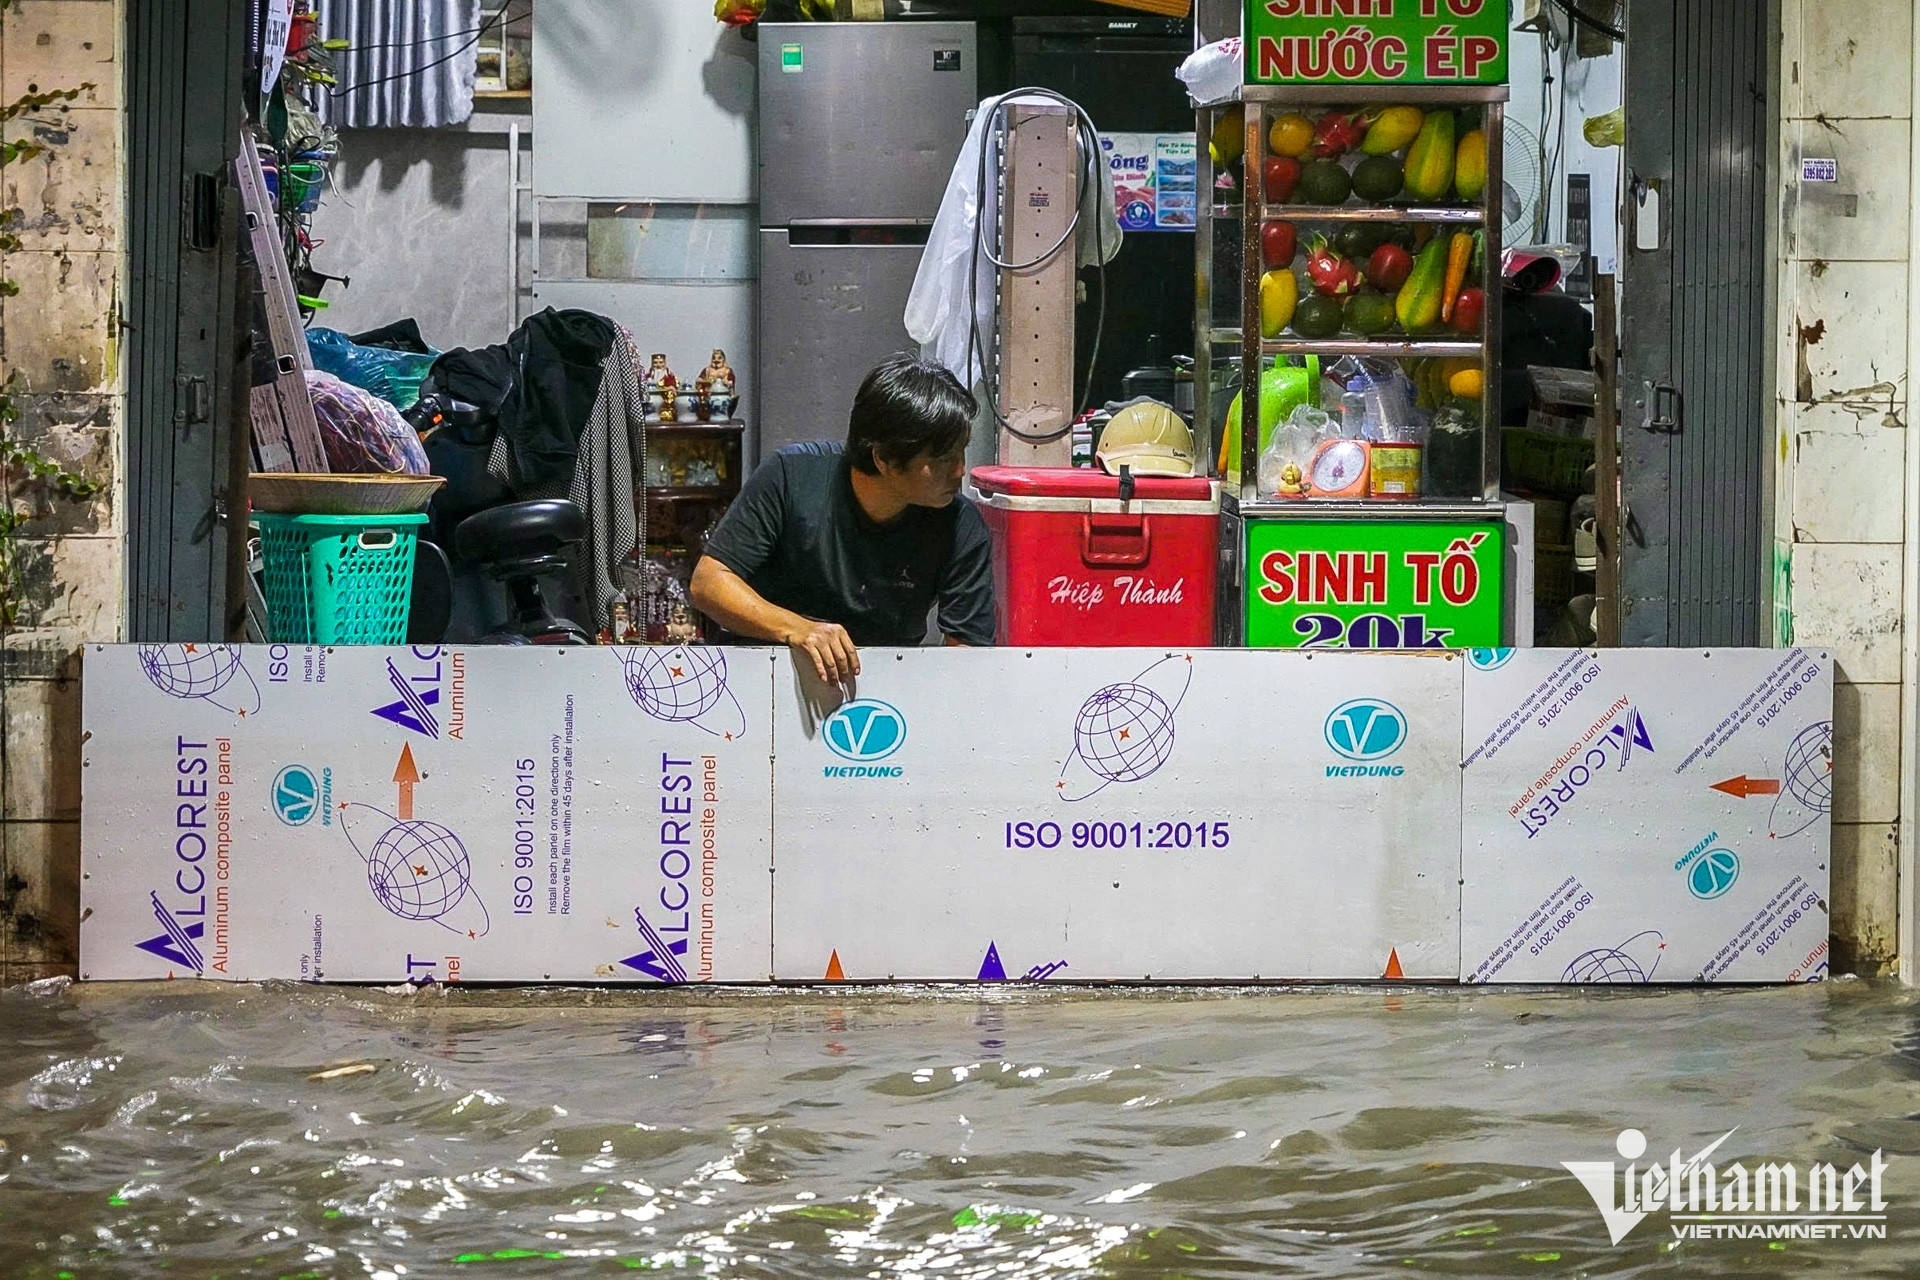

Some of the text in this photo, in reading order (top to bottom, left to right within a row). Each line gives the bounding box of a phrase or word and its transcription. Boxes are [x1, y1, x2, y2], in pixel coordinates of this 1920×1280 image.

[1258, 25, 1499, 79] NƯỚC ÉP
[1259, 532, 1490, 606] SINH TỐ
[1048, 576, 1183, 611] Hiệp Thành
[1293, 613, 1453, 648] 20k
[269, 644, 288, 682] ISO
[303, 655, 312, 682] Install
[1558, 648, 1583, 672] Remove
[1777, 648, 1802, 672] Remove
[1536, 682, 1548, 694] film
[1548, 672, 1558, 682] the
[448, 653, 464, 739] Aluminum
[1485, 655, 1589, 760] Install each panel on one direction only
[1520, 693, 1536, 710] within
[1538, 664, 1601, 728] ISO 9001:2015
[1705, 654, 1810, 759] Install each panel on one direction only
[1739, 692, 1756, 710] within
[1756, 664, 1820, 728] ISO 9001:2015
[1497, 719, 1512, 734] days
[1511, 710, 1520, 721] 45
[1716, 718, 1731, 733] days
[1731, 710, 1739, 720] 45
[551, 734, 562, 754] only
[1484, 732, 1497, 746] after
[1704, 732, 1716, 746] after
[1508, 695, 1629, 818] Aluminum composite panel
[550, 756, 559, 795] direction
[701, 756, 718, 801] panel
[823, 765, 903, 778] VIETDUNG
[1325, 765, 1404, 777] VIETDUNG
[1521, 706, 1654, 839] ALCOREST
[322, 767, 332, 826] VIETDUNG
[561, 694, 574, 914] Remove the film within 45 days after installation
[514, 758, 535, 914] ISO 9001:2015
[552, 819, 558, 831] on
[1006, 822, 1230, 848] ISO 9001:2015
[134, 736, 207, 973] ALCOREST
[213, 737, 232, 973] Aluminum composite panel
[549, 834, 560, 859] panel
[700, 809, 717, 897] composite
[1675, 831, 1719, 870] VIETDUNG
[549, 862, 558, 884] each
[619, 752, 692, 982] ALCOREST
[1550, 876, 1576, 900] Remove
[1777, 876, 1802, 900] Remove
[1790, 882, 1808, 901] Install
[548, 887, 558, 914] Install
[1540, 900, 1551, 910] the
[1549, 900, 1564, 916] each
[1766, 899, 1777, 910] the
[1775, 900, 1790, 915] each
[1529, 910, 1541, 922] film
[1530, 892, 1594, 956] ISO 9001:2015
[1534, 914, 1549, 934] panel
[1755, 910, 1767, 921] film
[1757, 891, 1820, 955] ISO 9001:2015
[1760, 913, 1776, 933] panel
[313, 914, 322, 963] installation
[1512, 921, 1529, 939] within
[1524, 931, 1533, 940] on
[1739, 920, 1756, 938] within
[1751, 930, 1759, 940] on
[1489, 946, 1504, 961] days
[1503, 938, 1512, 949] 45
[1513, 940, 1525, 952] one
[1715, 946, 1730, 961] days
[1730, 938, 1738, 948] 45
[1740, 939, 1751, 951] one
[300, 954, 310, 973] only
[1490, 950, 1513, 977] direction
[1716, 950, 1740, 974] direction
